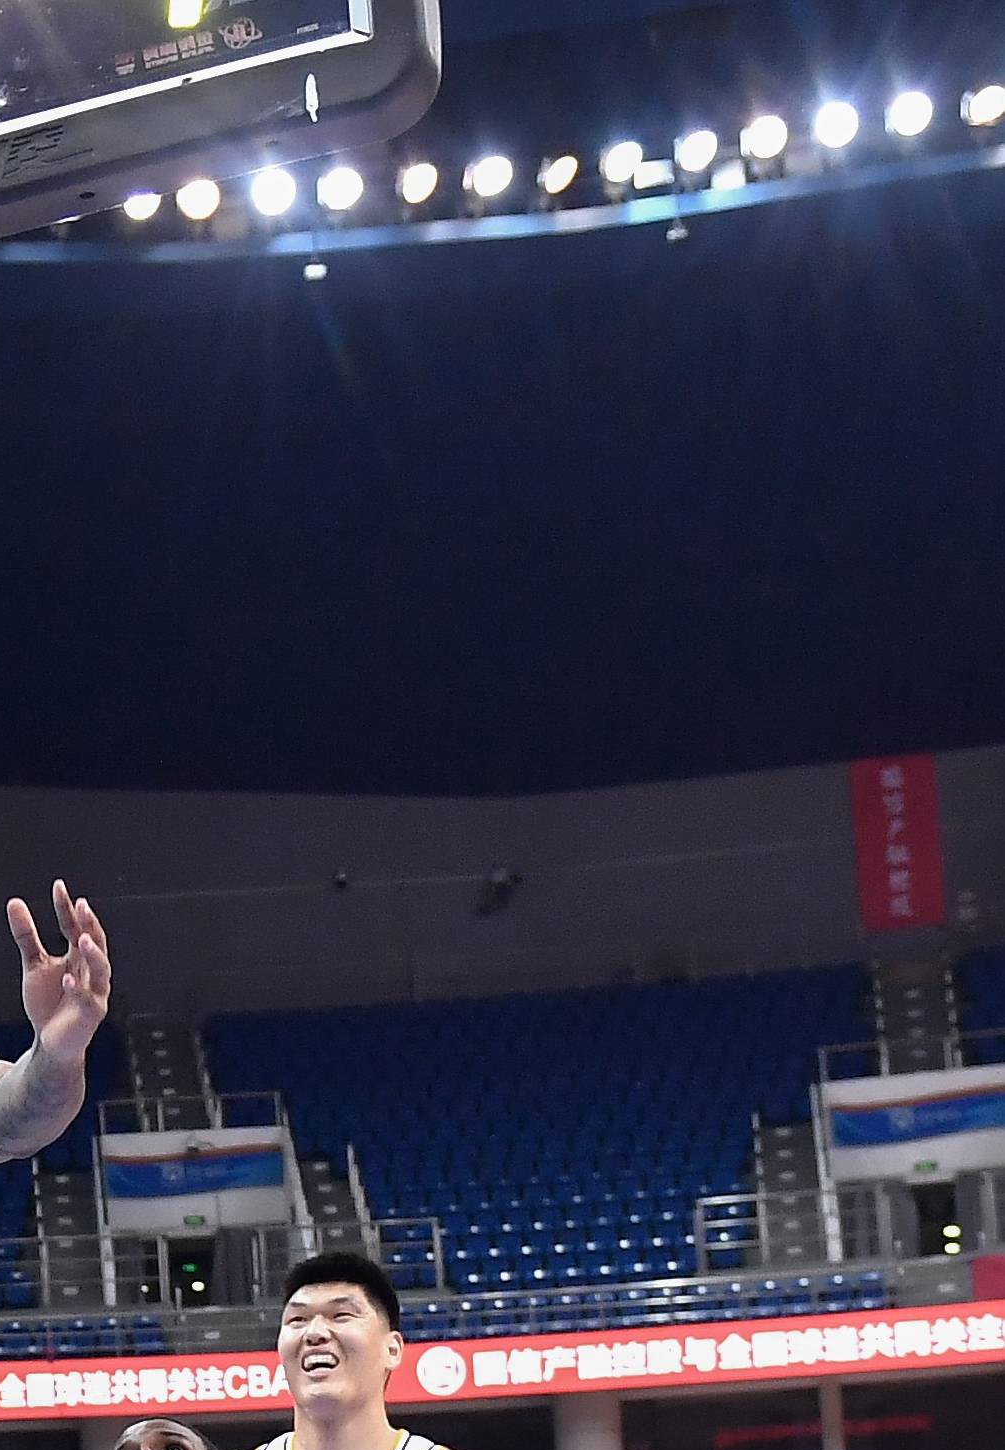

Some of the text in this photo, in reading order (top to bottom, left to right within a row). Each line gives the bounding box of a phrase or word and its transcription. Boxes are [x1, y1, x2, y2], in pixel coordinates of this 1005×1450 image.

[473, 1313, 1005, 1388] 国信产融控股与全国球迷共同关注
